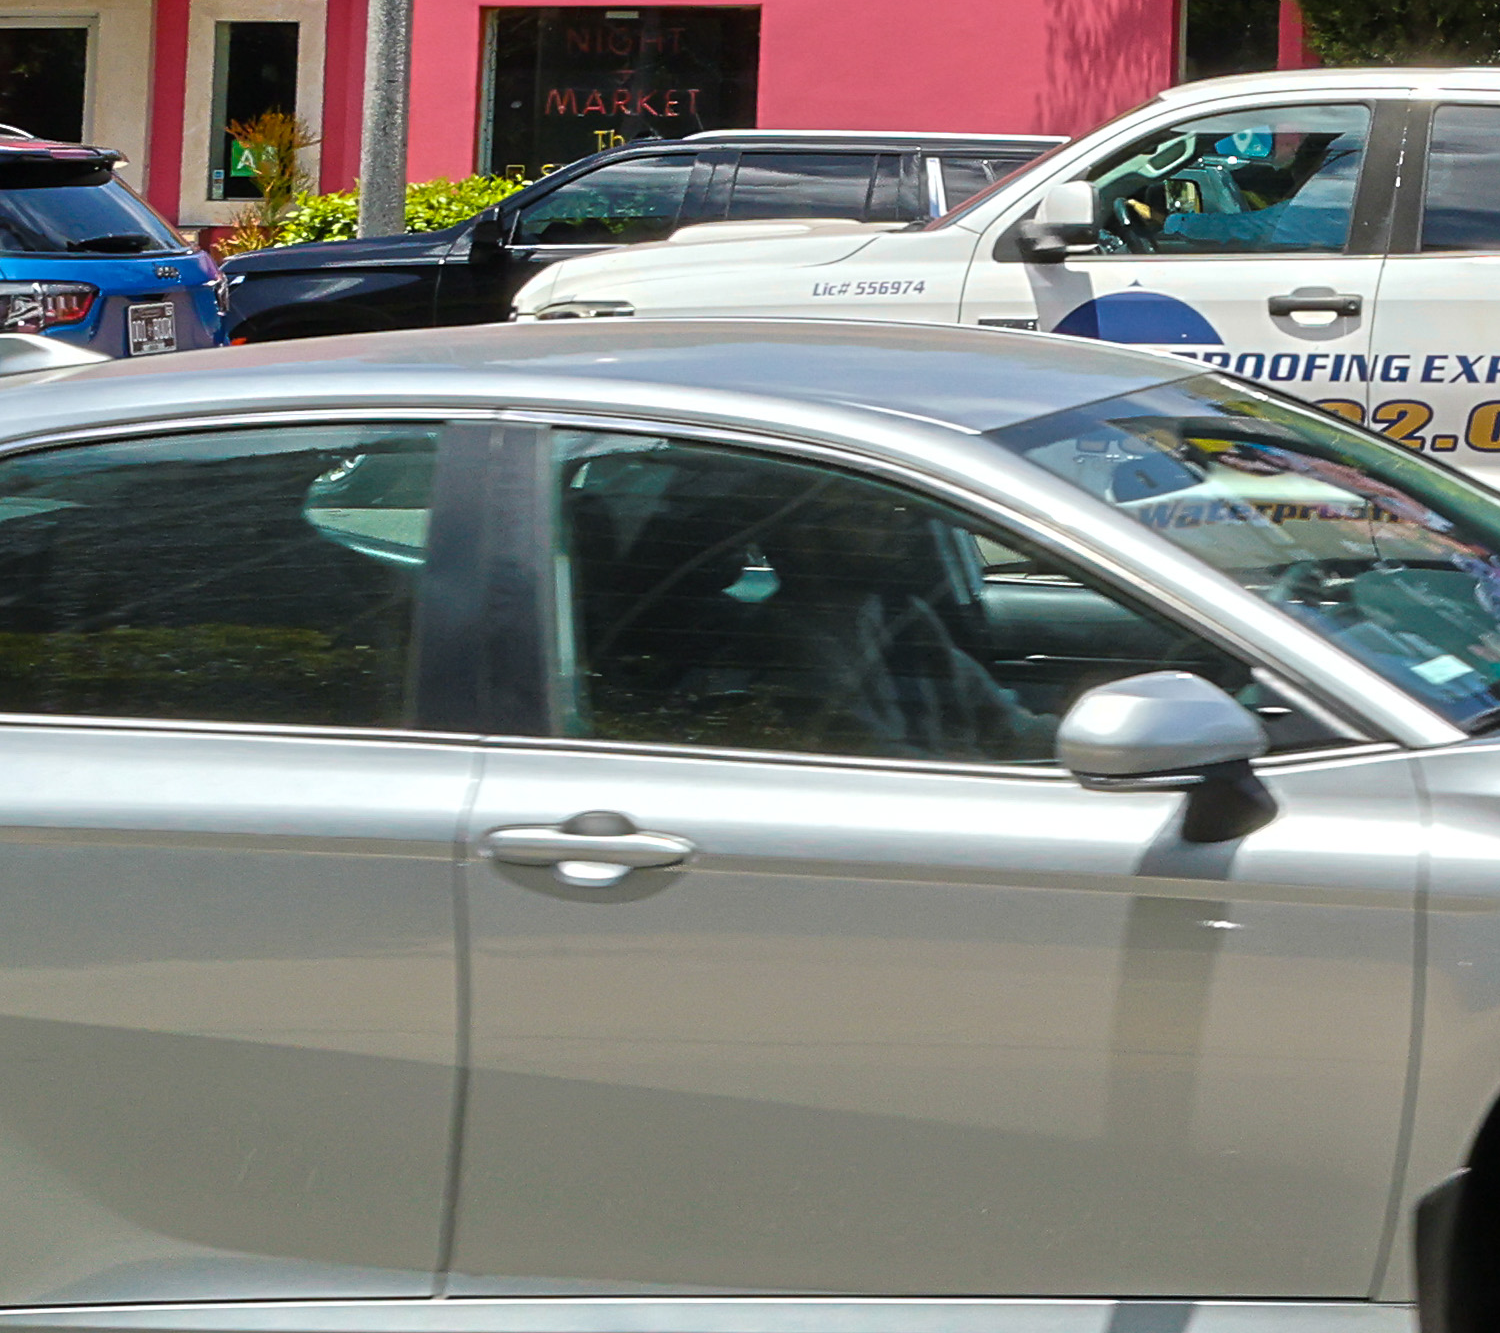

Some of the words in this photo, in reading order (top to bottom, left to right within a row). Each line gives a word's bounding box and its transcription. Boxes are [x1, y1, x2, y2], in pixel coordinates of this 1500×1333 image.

[566, 27, 686, 56] NIGHT
[544, 88, 702, 117] MARKET
[812, 282, 851, 297] Lic#
[854, 280, 926, 296] 556974
[1171, 352, 1411, 383] ROOFING
